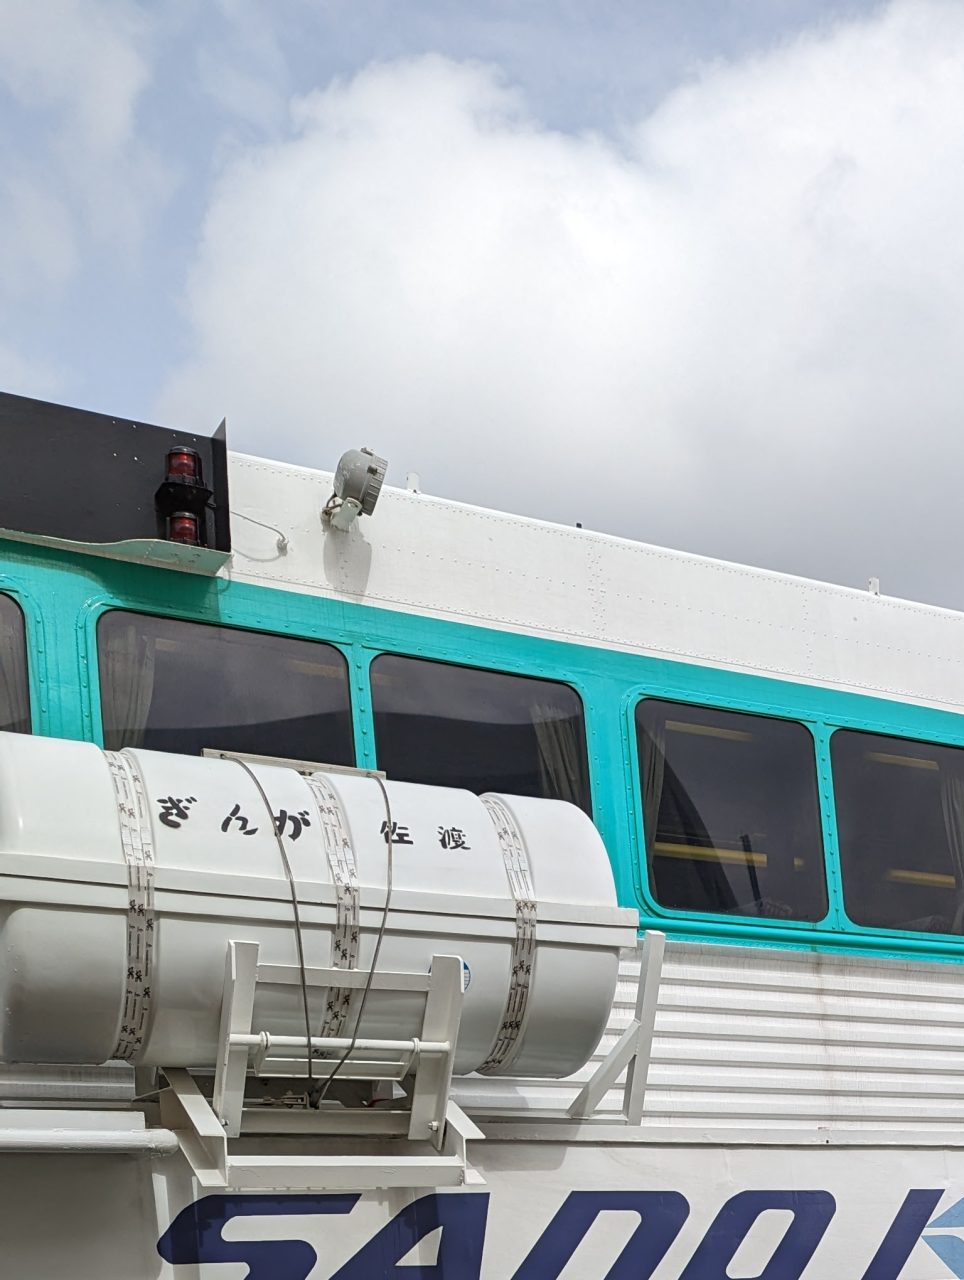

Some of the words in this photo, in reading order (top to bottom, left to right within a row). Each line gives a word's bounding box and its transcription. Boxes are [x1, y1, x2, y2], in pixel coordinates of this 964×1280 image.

[157, 796, 312, 841] ぎんが
[380, 820, 472, 850] 佐渡
